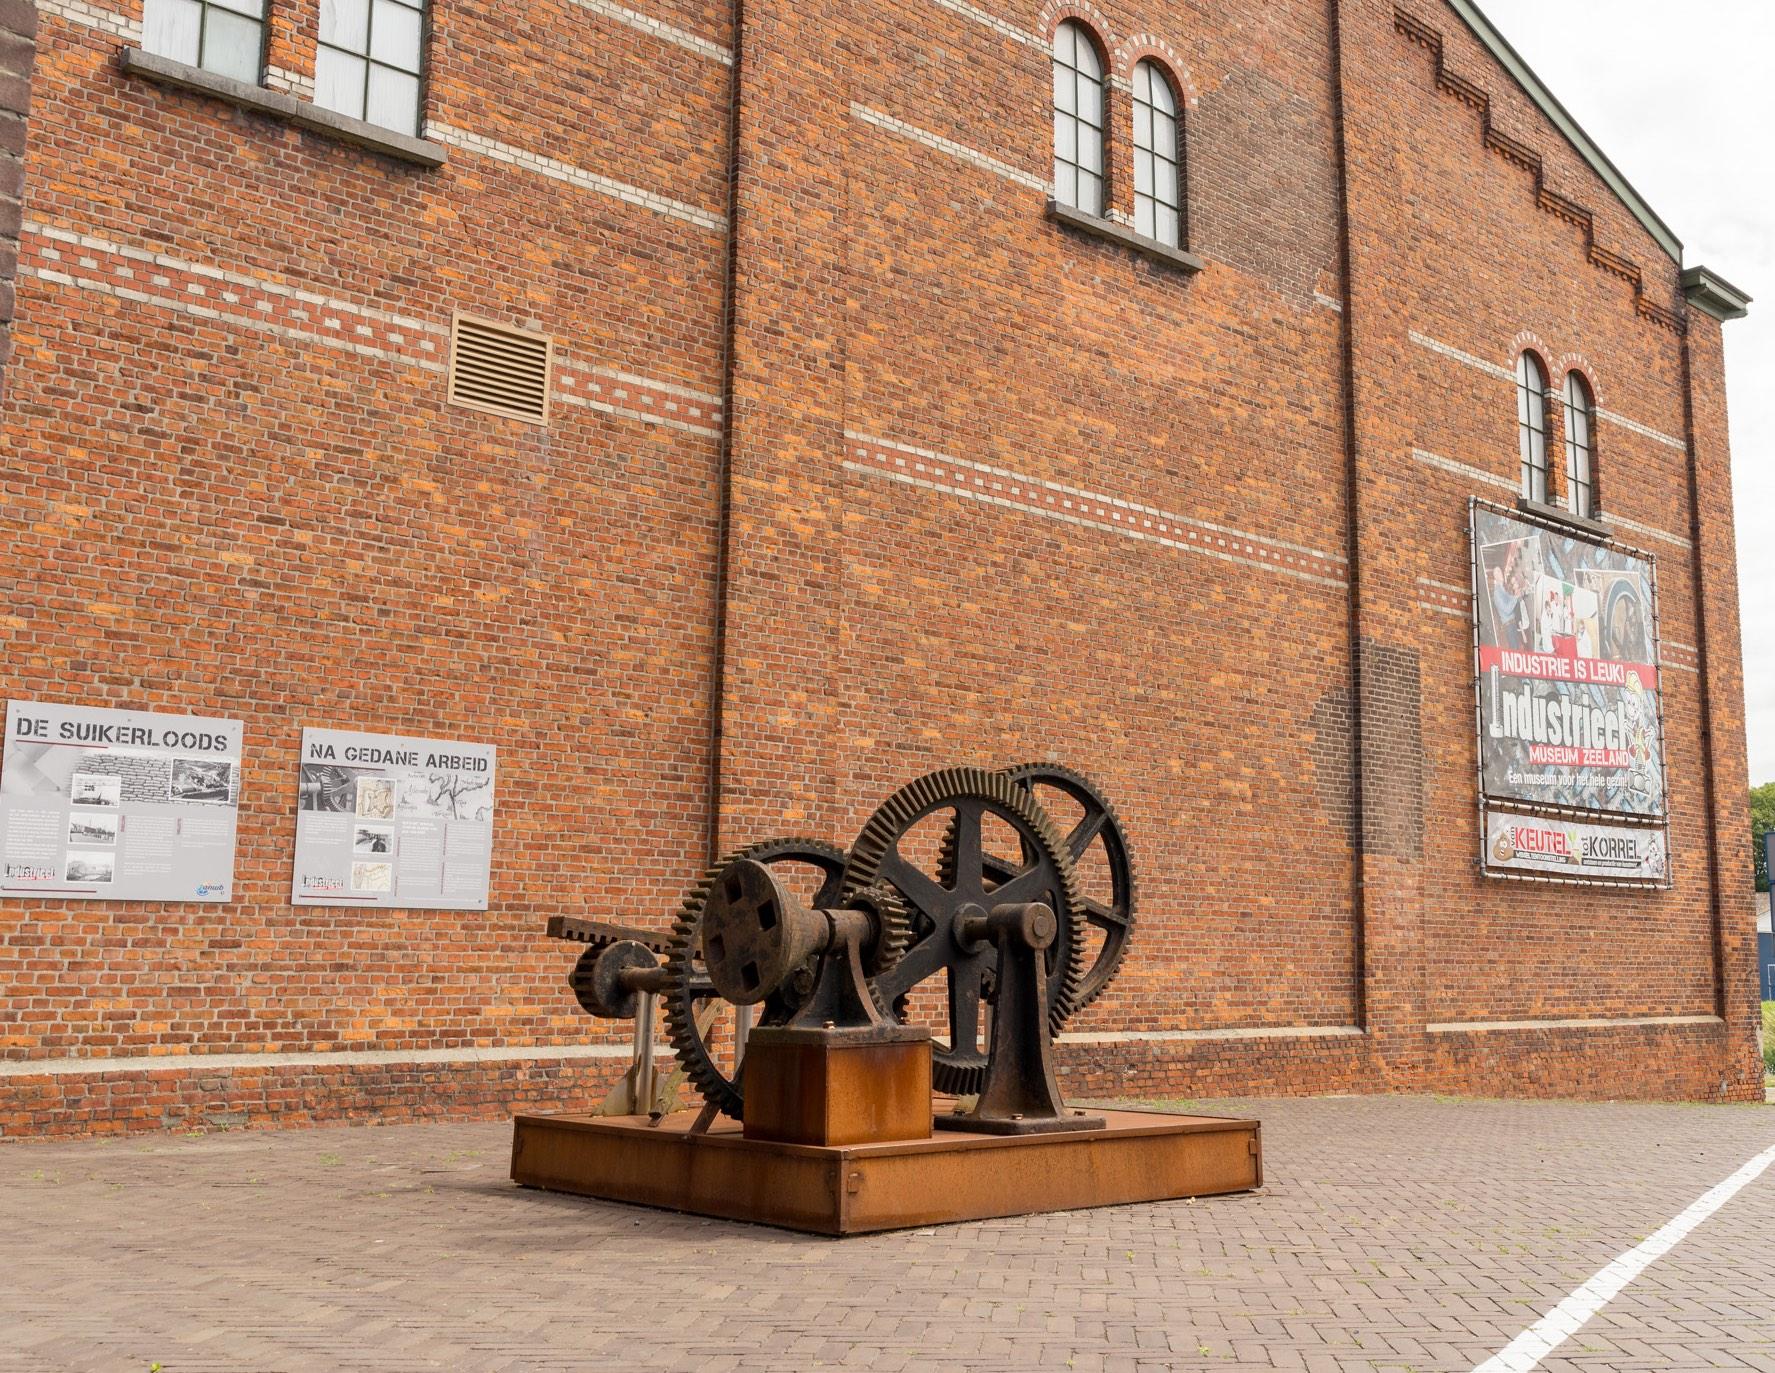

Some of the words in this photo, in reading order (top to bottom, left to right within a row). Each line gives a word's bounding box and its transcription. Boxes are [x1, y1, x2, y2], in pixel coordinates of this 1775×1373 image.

[1501, 651, 1571, 678] INDUSTRIE
[1574, 660, 1587, 680] IS
[1590, 662, 1625, 683] LEUK!
[16, 717, 49, 738] DE
[59, 721, 228, 752] SUIKERLOODS
[310, 743, 336, 760] NA
[344, 746, 419, 767] GEDANE
[426, 753, 488, 772] ARBEID
[1529, 747, 1579, 764] MUSEUM
[1583, 749, 1629, 766] ZEELAND
[1524, 772, 1557, 786] museum
[1558, 774, 1575, 787] voor
[1589, 774, 1605, 787] hele
[1515, 827, 1571, 855] KEUTEL
[1590, 836, 1642, 860] KORREL
